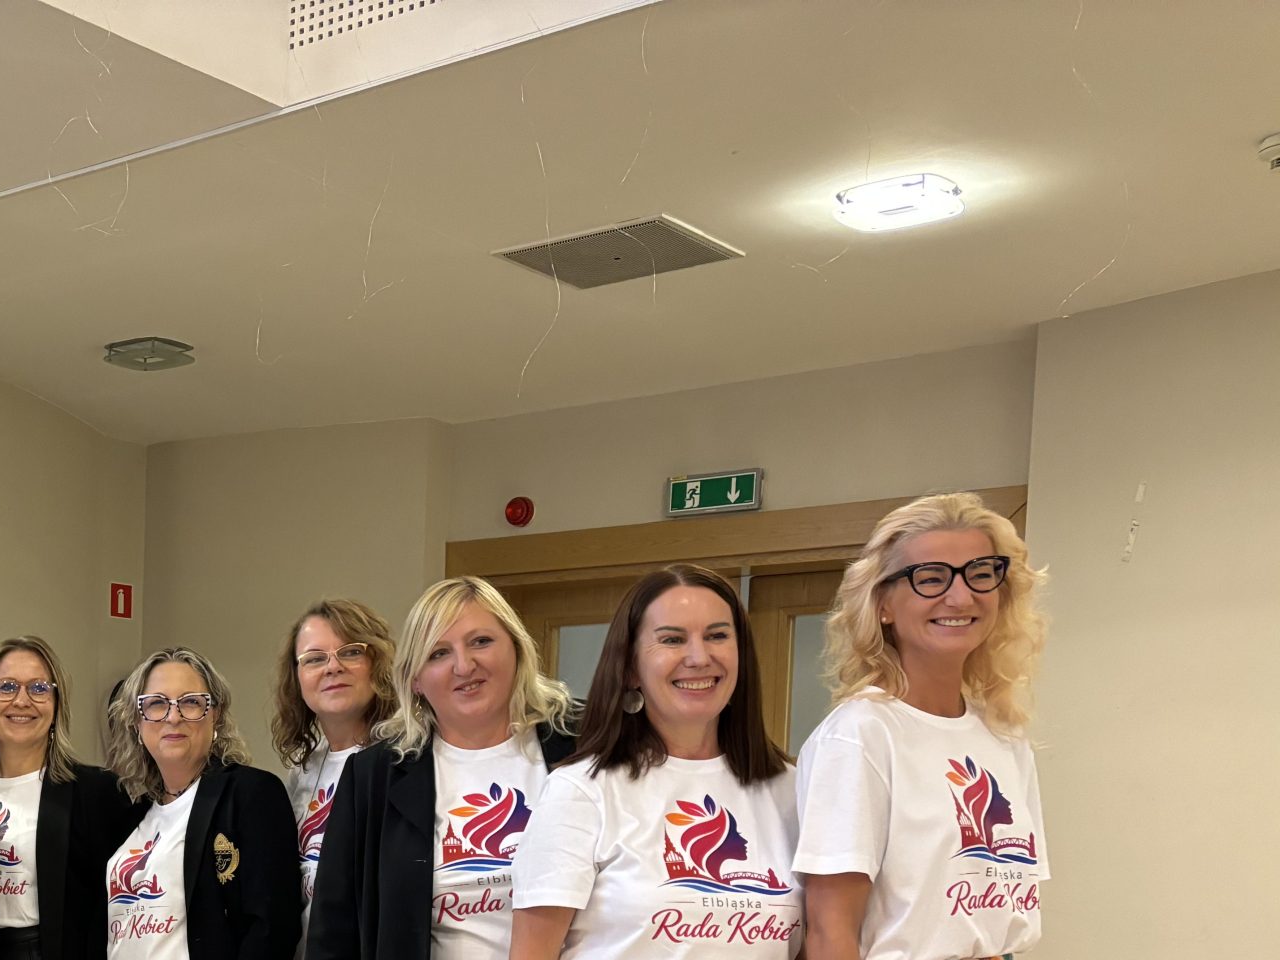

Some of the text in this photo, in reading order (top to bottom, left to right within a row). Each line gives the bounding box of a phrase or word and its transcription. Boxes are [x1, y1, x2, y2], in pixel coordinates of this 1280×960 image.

[431, 887, 506, 924] Rada
[701, 897, 763, 911] Elbląska
[946, 880, 1007, 917] Rada
[128, 913, 178, 940] Kobiet
[651, 908, 723, 943] Rada
